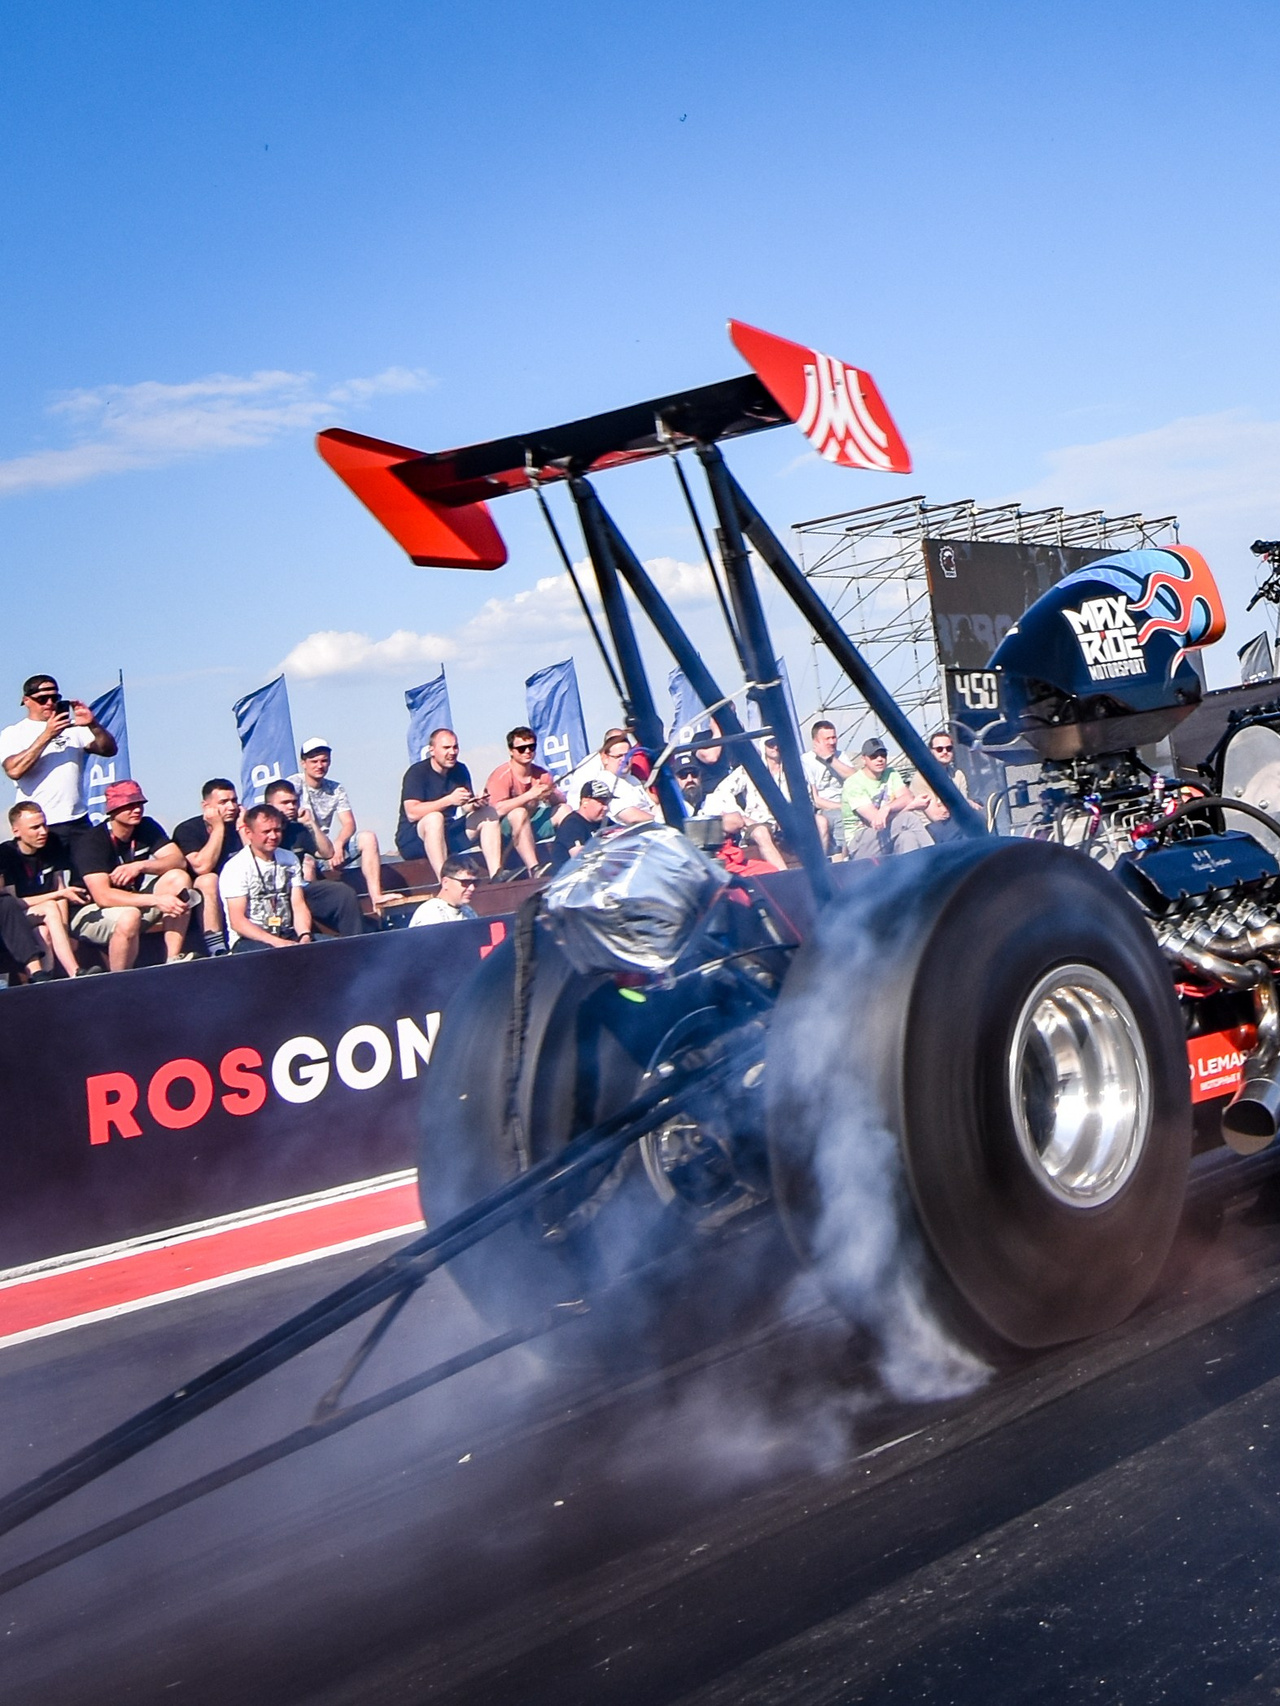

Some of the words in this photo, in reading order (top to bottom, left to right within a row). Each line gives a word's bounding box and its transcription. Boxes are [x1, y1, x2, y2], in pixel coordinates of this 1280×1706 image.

[1061, 595, 1135, 634] MAX
[1077, 627, 1144, 665] RIDE
[1088, 658, 1147, 681] MOTORSPORT
[955, 672, 998, 709] 450
